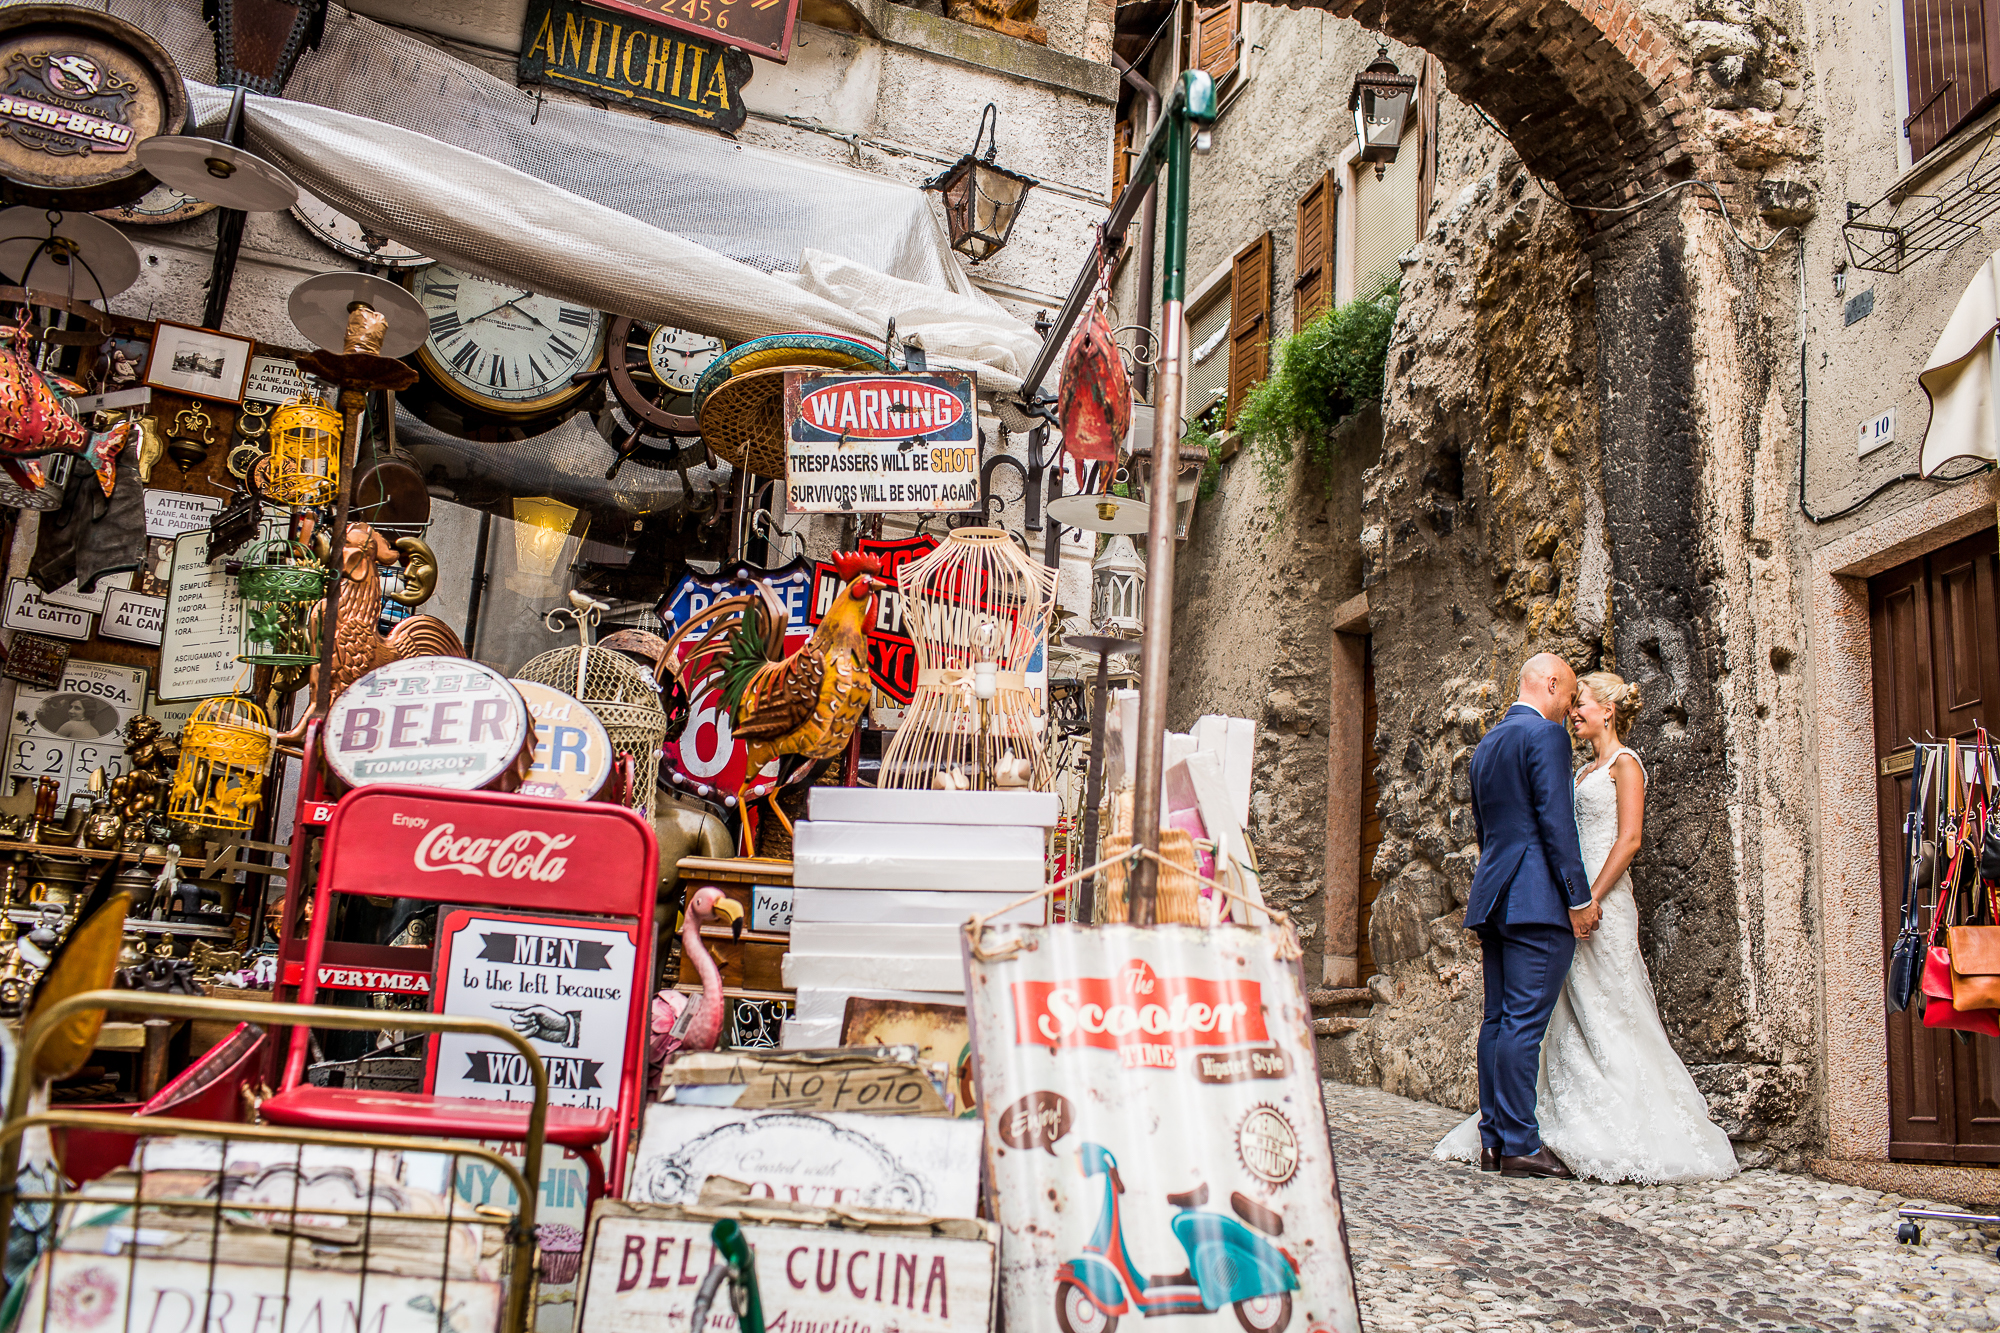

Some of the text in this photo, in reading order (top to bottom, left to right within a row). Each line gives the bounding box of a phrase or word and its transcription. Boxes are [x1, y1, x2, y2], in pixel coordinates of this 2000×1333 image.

[14, 87, 110, 119] AUGSBURGER
[662, 333, 677, 344] 10
[659, 356, 670, 368] 8
[249, 373, 259, 381] AL
[260, 375, 281, 385] CANE,
[282, 378, 292, 386] AL
[666, 367, 677, 380] 7
[679, 374, 690, 386] 6
[247, 381, 254, 389] E
[255, 382, 268, 392] AL
[810, 388, 953, 430] WARNING
[1874, 416, 1890, 438] 10
[790, 447, 976, 473] TRESPASSERS WILL BE SHOT
[790, 483, 977, 503] SURVIVORS WILL BE SHOT AGAIN
[151, 517, 165, 527] AL
[155, 510, 178, 519] CANE,
[179, 512, 189, 520] AL
[179, 580, 213, 591] SEMPLICE
[178, 592, 203, 603] DOPPIA
[15, 605, 82, 626] AL GATTO
[115, 614, 133, 627] AL
[174, 627, 192, 636] 1ORA
[174, 651, 222, 663] ASCIUGAMANO
[173, 664, 200, 674] SAPONE
[366, 672, 494, 697] FREE
[339, 698, 512, 754] BEER
[13, 740, 64, 774] £ 2
[76, 747, 123, 781] £ 5
[364, 754, 478, 775] TOMORROW
[392, 812, 429, 830] Enjoy
[413, 823, 577, 883] Coca-Cola
[511, 935, 580, 970] MEN
[463, 967, 622, 1001] to the left because
[1123, 962, 1156, 995] The
[1037, 987, 1249, 1041] Scooter
[1119, 1044, 1177, 1069] TIME
[1201, 1051, 1285, 1079] Hipster Style
[771, 1070, 824, 1098] NO
[833, 1068, 923, 1109] FOTO
[1009, 1097, 1063, 1142] Enjoy!
[803, 1158, 842, 1177] with
[785, 1246, 949, 1319] CUCINA
